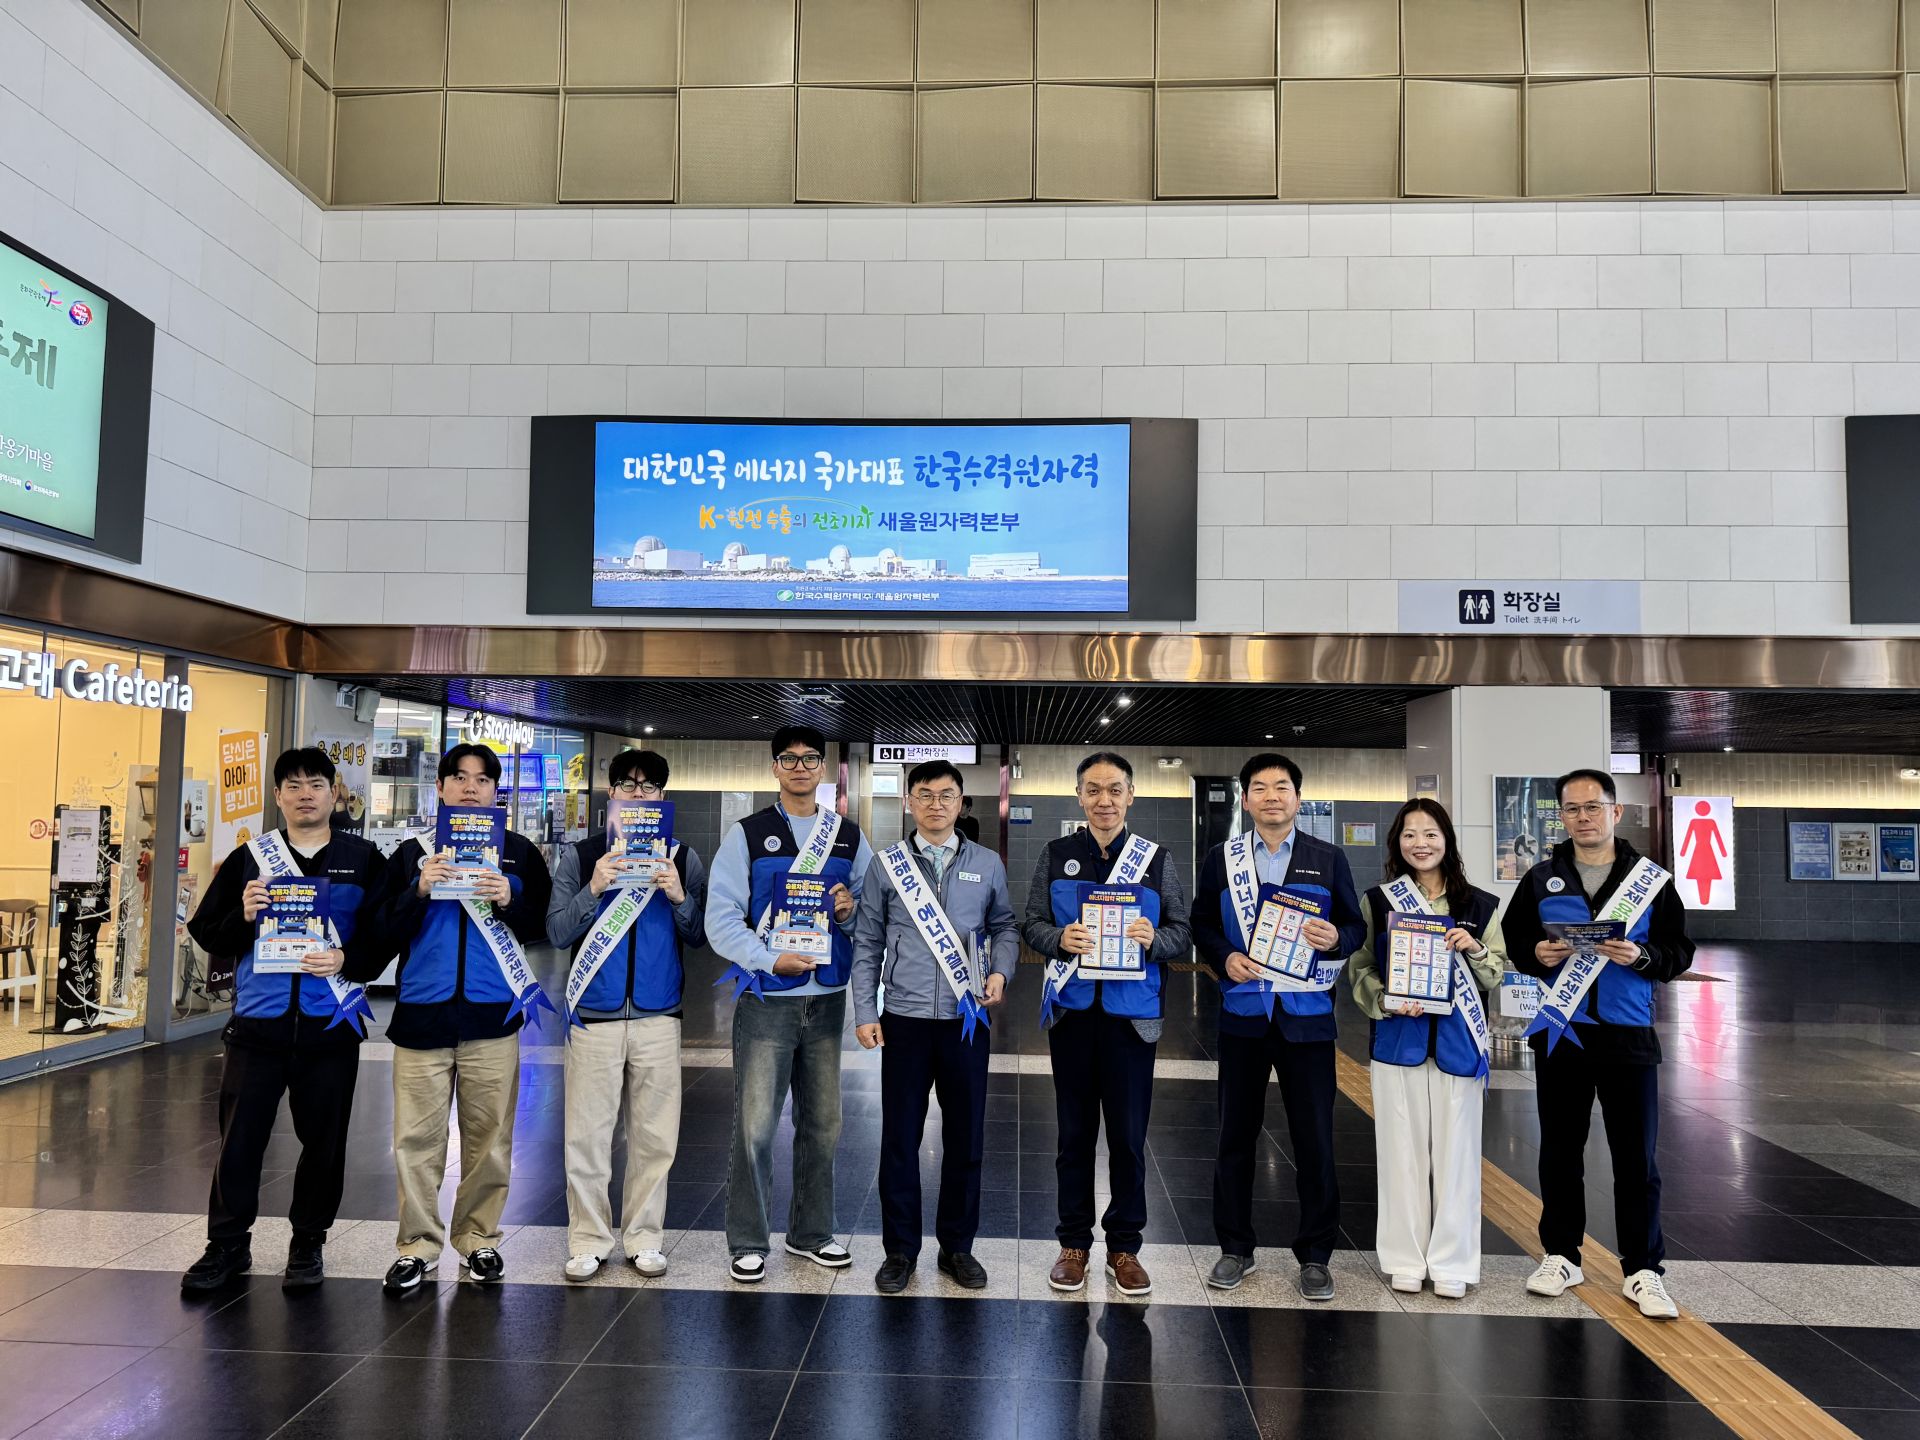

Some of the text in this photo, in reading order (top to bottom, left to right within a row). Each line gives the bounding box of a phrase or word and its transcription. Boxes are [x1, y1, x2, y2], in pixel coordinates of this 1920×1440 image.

[0, 319, 57, 389] 제
[623, 449, 1099, 492] 대한민국 에너지 국가대표 한국수력원자력
[812, 507, 872, 531] 전초기지
[878, 510, 1020, 532] 새울원자력본부
[875, 591, 940, 601] 새울원자력본부
[1503, 591, 1561, 613] 화장실
[1504, 615, 1529, 624] Toilet
[1533, 616, 1558, 624] 洗手间
[1562, 616, 1581, 624] トイレ
[62, 656, 193, 712] Cafeteria
[223, 738, 256, 764] 당신은
[907, 747, 949, 758] 남자화장실
[224, 762, 258, 788] 아아가
[225, 790, 258, 813] 땡긴다
[1388, 880, 1425, 915] 함께
[1609, 862, 1666, 922] 차5부제(요
[1454, 963, 1487, 1040] 너지절약
